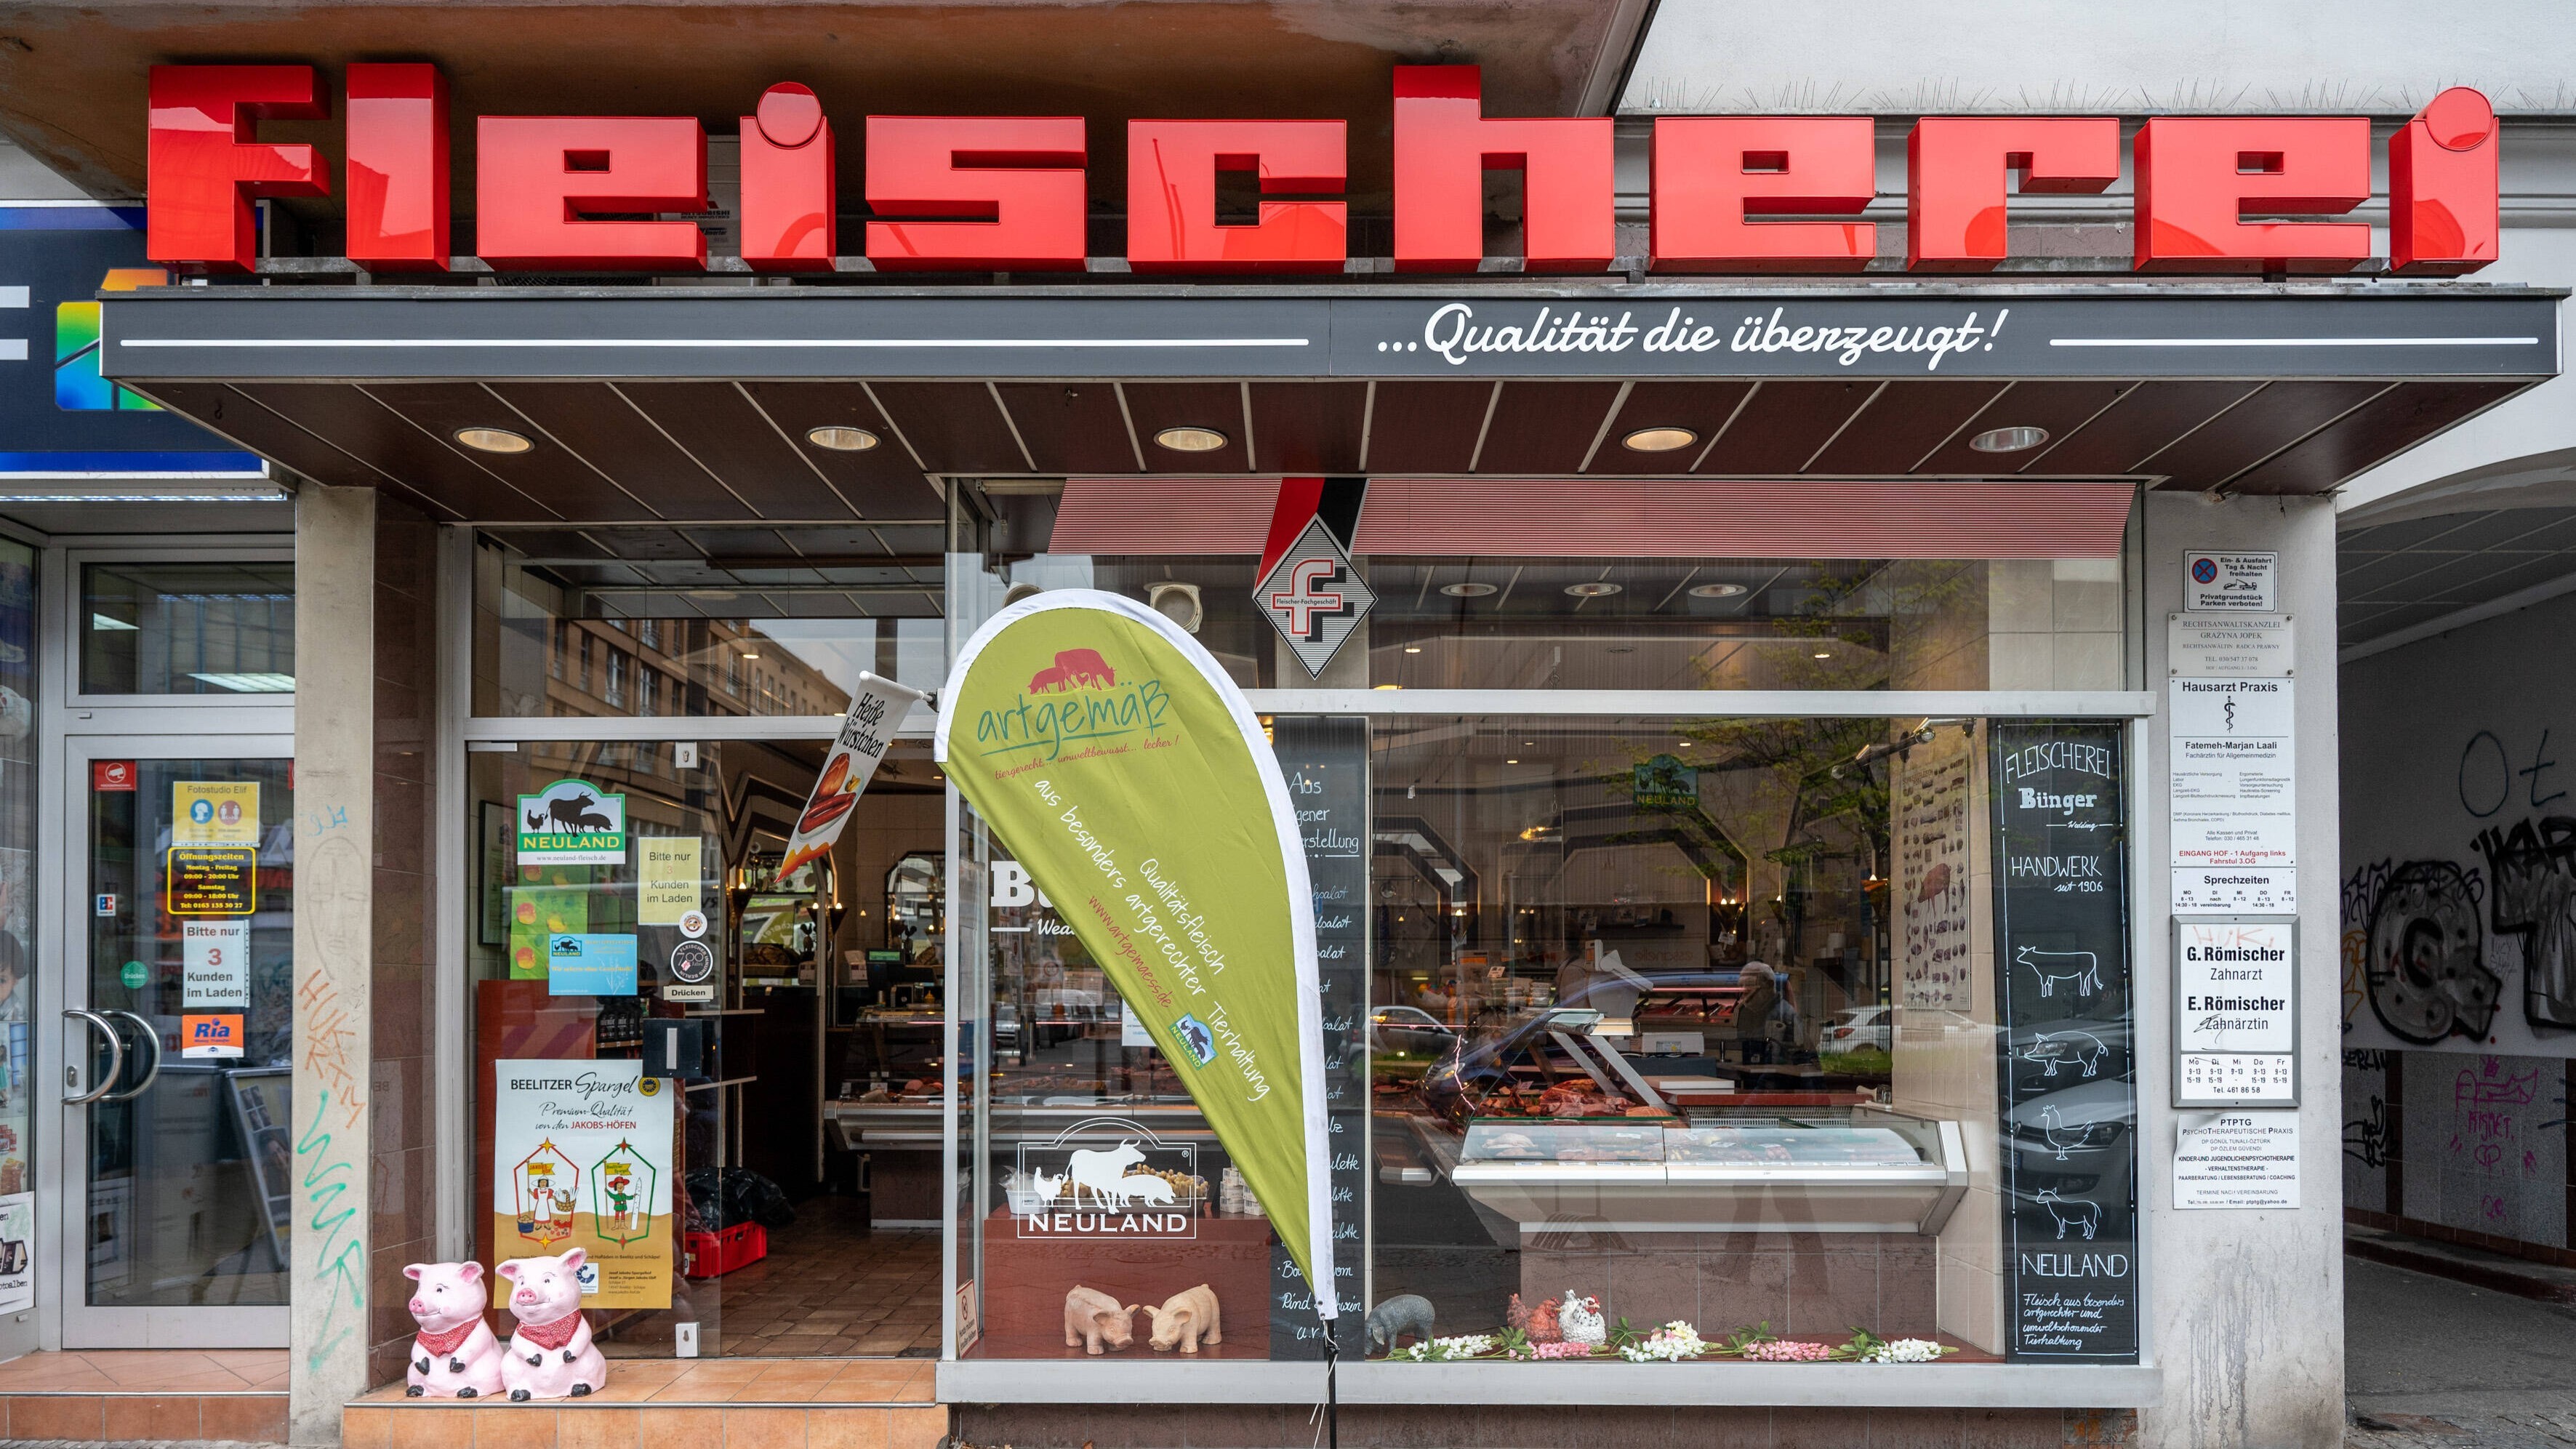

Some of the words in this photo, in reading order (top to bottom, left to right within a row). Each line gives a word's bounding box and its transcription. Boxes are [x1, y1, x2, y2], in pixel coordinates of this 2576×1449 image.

[148, 63, 2500, 273] Fleischerei
[1642, 307, 1721, 353] die
[1730, 306, 2009, 371] überzeugt!
[2183, 682, 2236, 691] Hausarzt
[2240, 682, 2278, 691] Praxis
[852, 692, 885, 728] Heiße
[978, 680, 1169, 761] artgemäß
[838, 717, 884, 758] Würstchen
[2186, 742, 2254, 750] Fatemeh-Marjan
[2005, 742, 2111, 784] FLEISCHEREI
[187, 785, 231, 794] Fotostudio
[233, 785, 247, 794] Elif
[1289, 771, 1322, 795] Aus
[1637, 794, 1696, 806] NEULAND
[2018, 787, 2097, 815] Bünger
[2068, 821, 2098, 832] Wedding
[523, 836, 619, 848] NEULAND
[1299, 828, 1360, 854] erstellung
[179, 851, 244, 863] Öffnungszeiten
[649, 852, 671, 861] Bitte
[2012, 856, 2103, 878] HANDWERK
[651, 880, 689, 889] Kunden
[2055, 883, 2077, 893] seit
[2078, 881, 2103, 892] 1906
[2204, 875, 2269, 886] Sprechzeiten
[662, 894, 693, 903] Laden
[1139, 857, 1227, 975] Qualitätsfleisch
[187, 927, 216, 936] Bitte
[1035, 779, 1062, 807] aus
[1060, 806, 1126, 888] besonders
[1125, 893, 1207, 997] artgerechter
[1206, 1000, 1271, 1102] Tierhaltung
[208, 948, 222, 966] 3
[1088, 894, 1173, 1008] www.artgemaess.de
[2187, 947, 2201, 961] G.
[2204, 947, 2284, 961] Römischer
[187, 972, 233, 982] Kunden
[2210, 968, 2263, 980] Zahnarzt
[187, 988, 201, 998] im
[206, 988, 243, 998] Laden
[2188, 996, 2201, 1011] E.
[2204, 996, 2285, 1011] Römischer
[194, 1018, 230, 1038] Ria
[2205, 1017, 2268, 1029] Zahnärztin
[1171, 1026, 1202, 1068] NEULAND
[511, 1079, 572, 1091] BEELITZER
[574, 1072, 639, 1100] Spargel
[539, 1101, 634, 1117] Premium-Qualität
[552, 1120, 569, 1131] den
[571, 1120, 636, 1129] JAKOBS-HÖFEN
[1029, 1213, 1187, 1232] NEULAND
[2022, 1253, 2128, 1277] NEULAND
[2023, 1293, 2061, 1307] Fleisch
[2063, 1297, 2081, 1306] aus
[2084, 1293, 2124, 1307] besonders
[2023, 1307, 2079, 1322] artgerechter
[2080, 1308, 2103, 1320] und
[2023, 1322, 2107, 1334] umweltschonender
[2024, 1333, 2083, 1351] Tierhaltung
